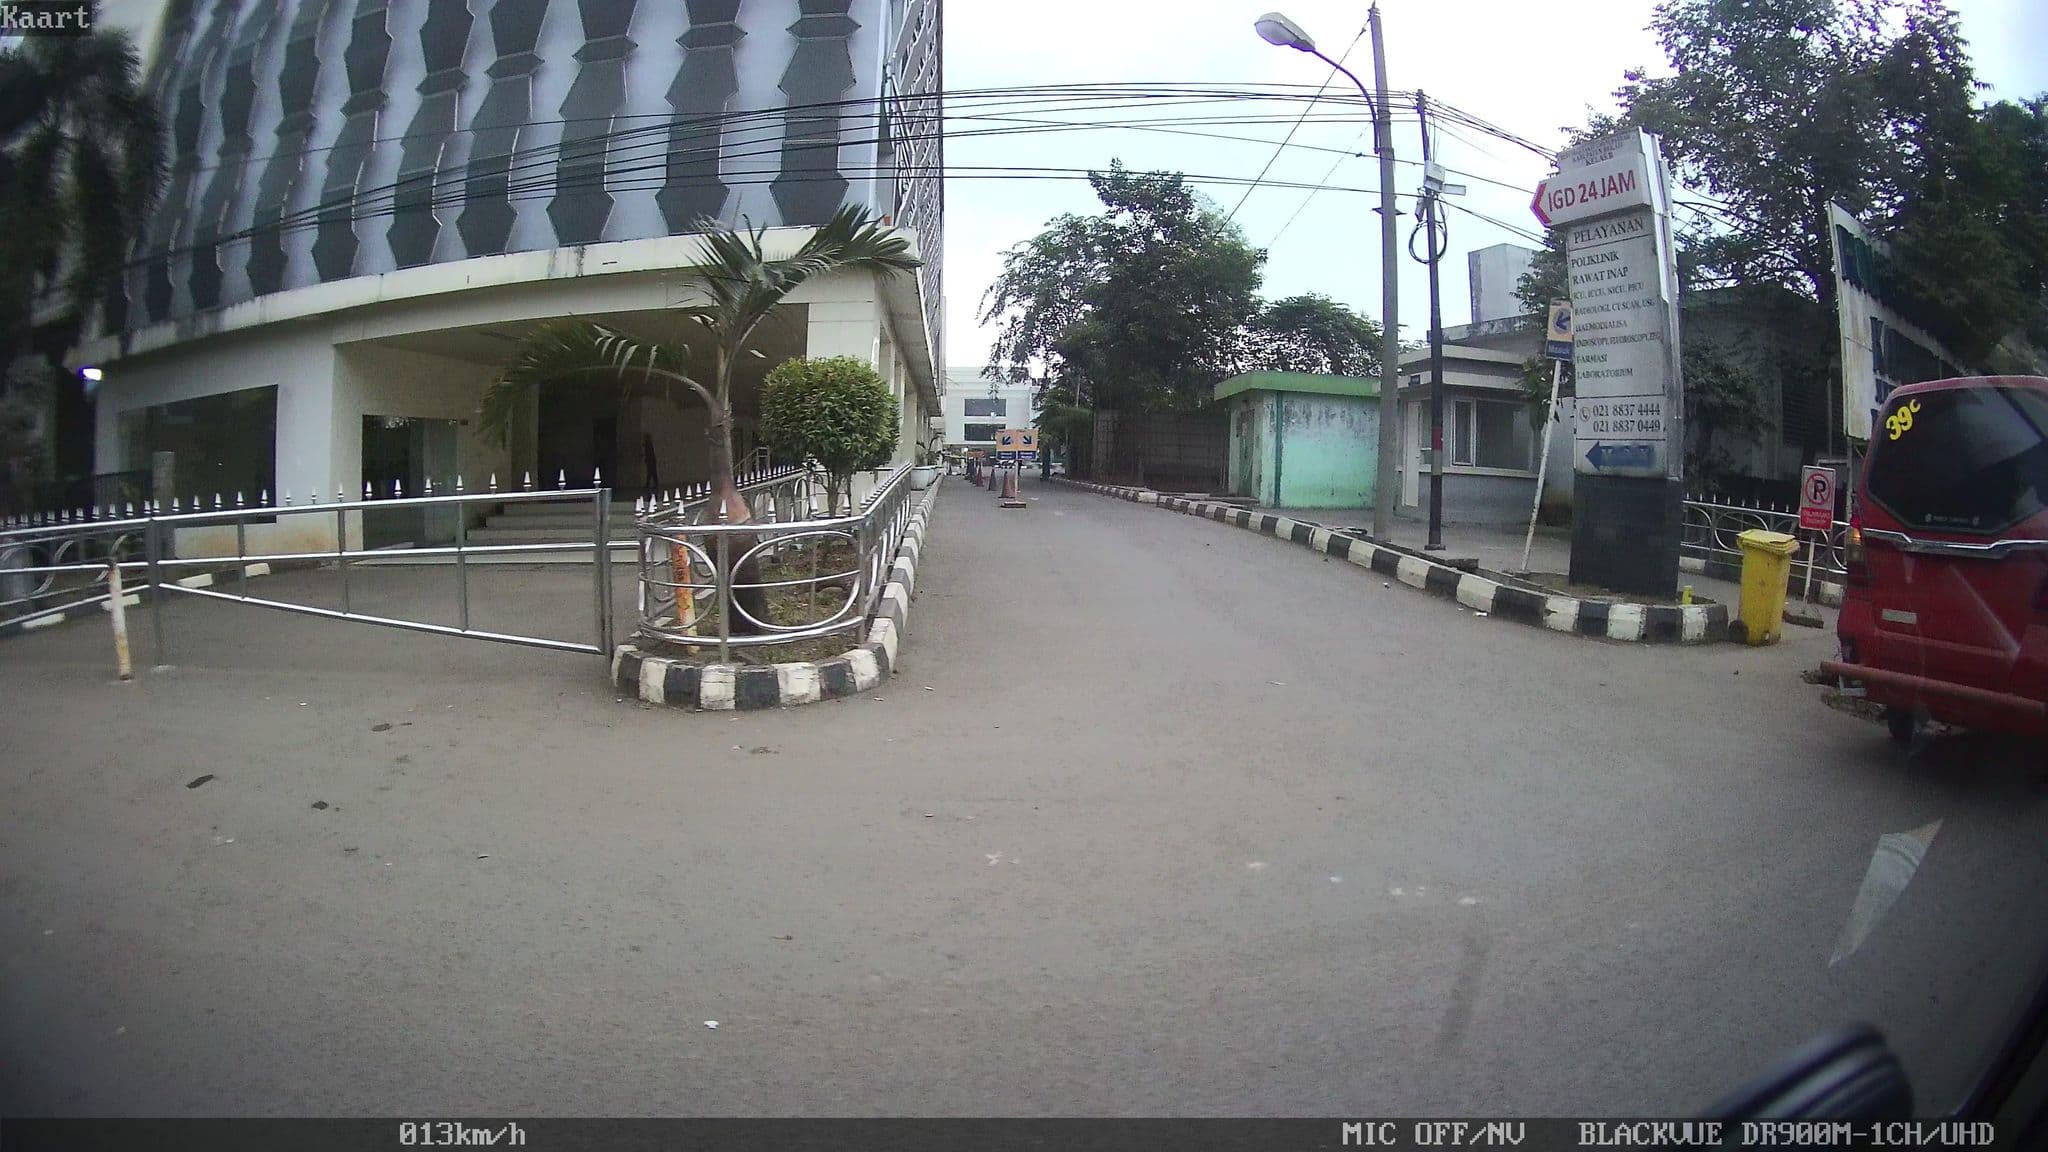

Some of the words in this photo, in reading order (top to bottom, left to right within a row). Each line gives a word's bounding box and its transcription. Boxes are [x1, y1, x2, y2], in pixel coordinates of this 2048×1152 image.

[1548, 187, 1576, 212] IGD
[1579, 181, 1598, 204] 24
[1600, 169, 1636, 198] JAM
[1574, 217, 1645, 244] PELAYANAN
[1571, 250, 1620, 268] POLIKLINIK
[1573, 270, 1606, 286] RAWAT
[1606, 266, 1629, 280] INAP
[1577, 353, 1607, 364] FARMASI
[1577, 368, 1634, 380] LABORATORIUM
[1593, 405, 1609, 417] 021
[1612, 404, 1635, 417] 8837
[1638, 403, 1661, 416] 4444
[1593, 420, 1609, 433] 021
[1612, 420, 1635, 433] 8837
[1637, 419, 1661, 432] 0449
